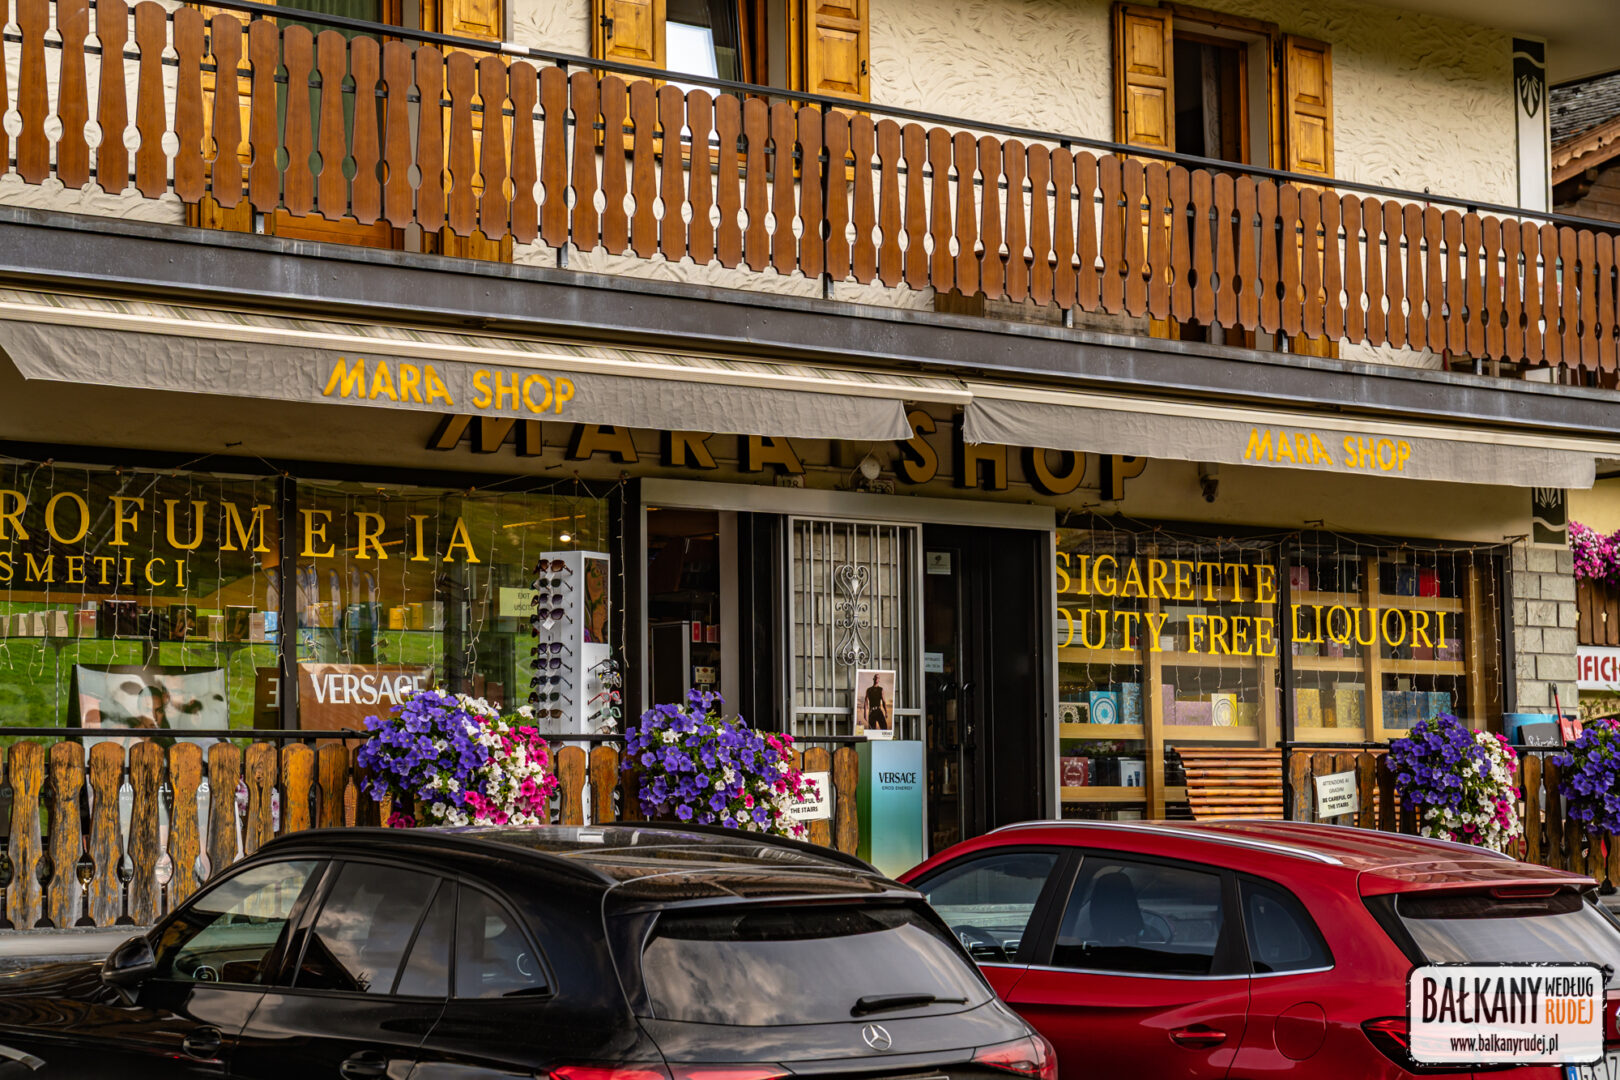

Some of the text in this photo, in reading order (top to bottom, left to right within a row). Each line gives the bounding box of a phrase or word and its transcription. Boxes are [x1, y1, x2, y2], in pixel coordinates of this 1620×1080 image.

[322, 356, 576, 415] MARA SHOP
[1244, 427, 1411, 471] MARA SHOP
[1056, 551, 1276, 604] SIGARETTE
[1186, 614, 1277, 657] FREE
[1290, 604, 1448, 649] LIQUORI
[310, 673, 427, 705] VERSACE
[1577, 655, 1620, 682] IFICI
[878, 772, 917, 784] VERSACE
